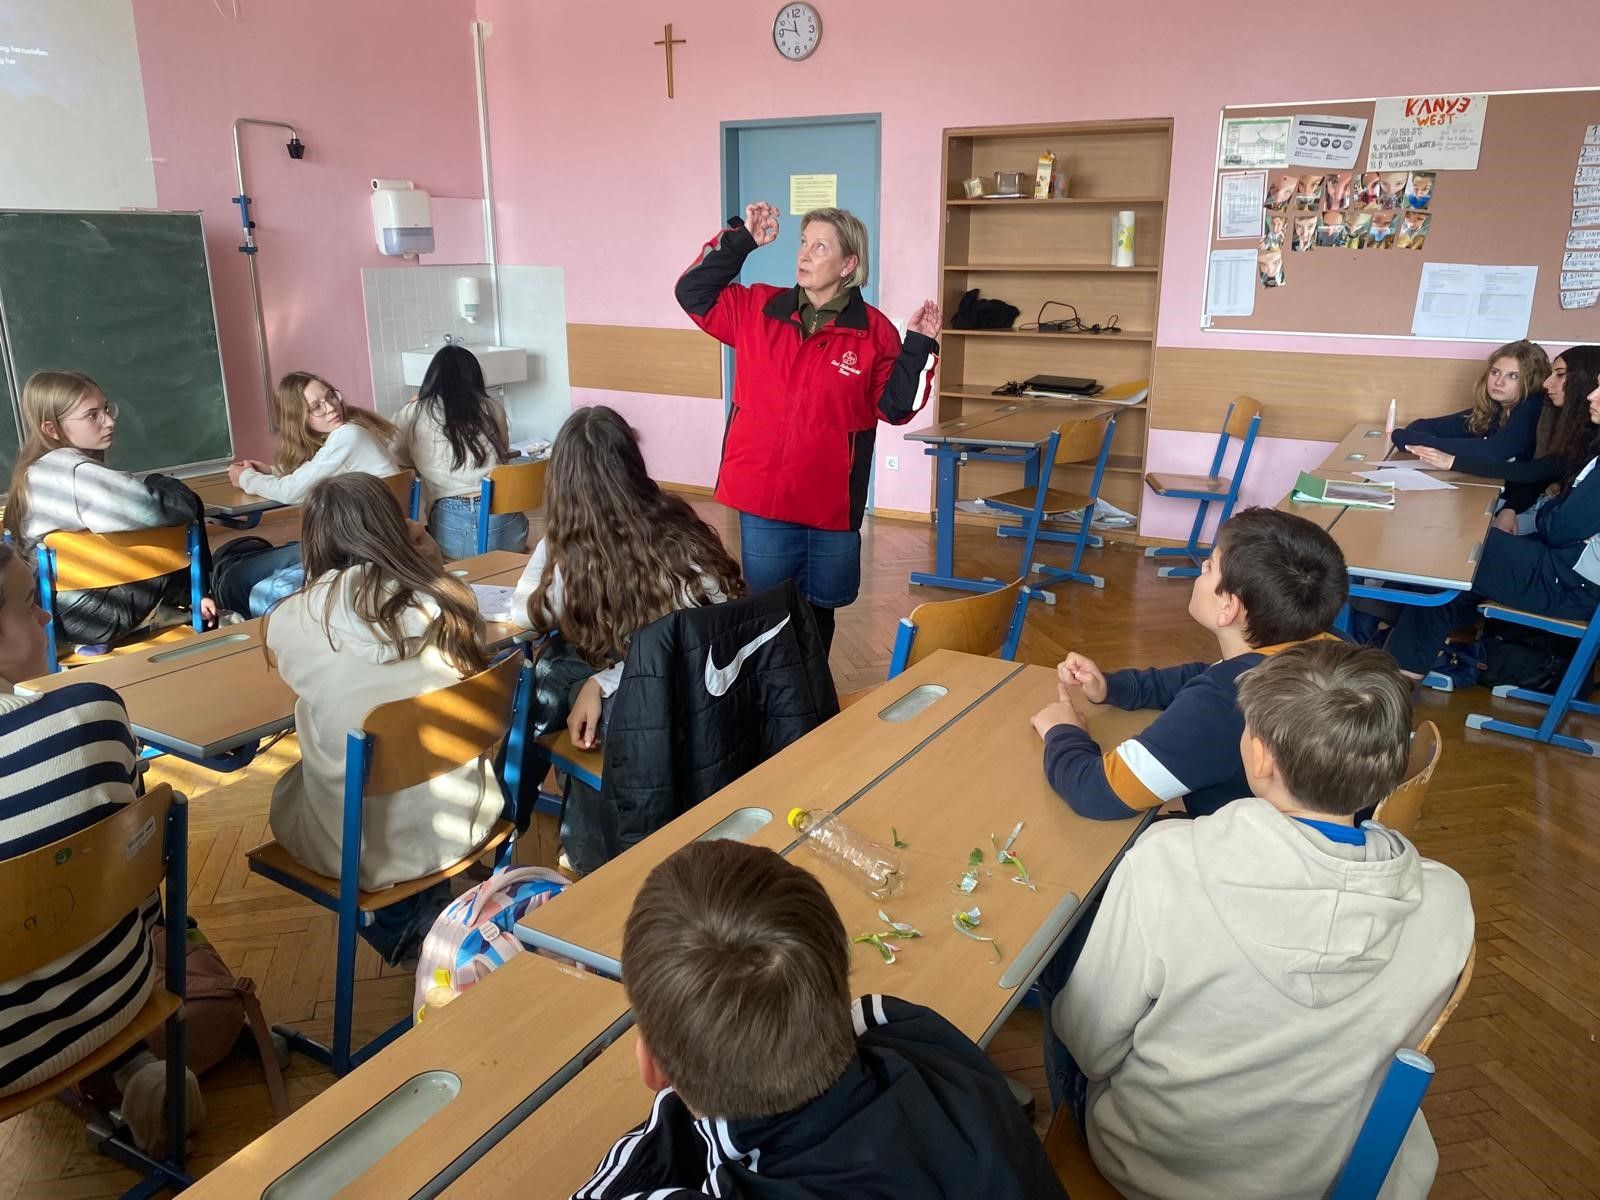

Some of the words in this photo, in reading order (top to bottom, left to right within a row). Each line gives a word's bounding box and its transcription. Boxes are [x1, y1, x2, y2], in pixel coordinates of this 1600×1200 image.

[791, 8, 801, 18] 12
[778, 28, 785, 38] 9
[808, 24, 815, 34] 3
[794, 45, 801, 54] 6
[1416, 113, 1456, 127] WEST
